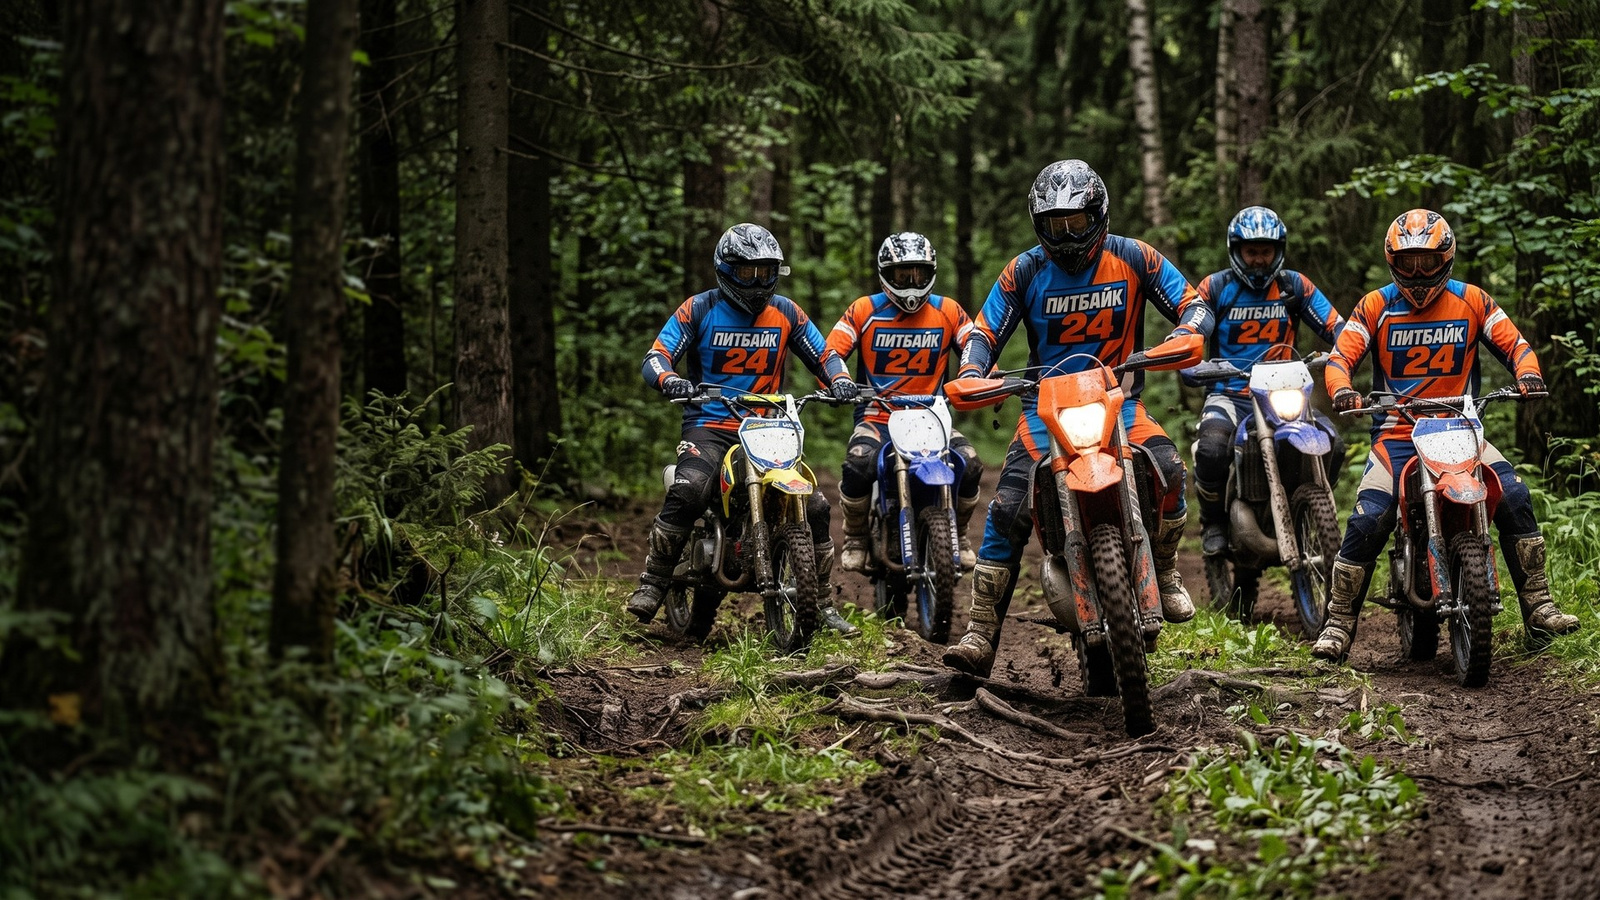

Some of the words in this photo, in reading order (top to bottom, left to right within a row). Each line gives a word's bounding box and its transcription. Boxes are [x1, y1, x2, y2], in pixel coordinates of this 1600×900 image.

[1045, 286, 1124, 314] ПИТБАЙК
[1228, 302, 1286, 320] ПИТБАЙК
[712, 330, 778, 347] ПИТБАЙК
[1059, 307, 1114, 344] 24
[1237, 318, 1280, 344] 24
[1390, 323, 1465, 346] ПИТБАЙК
[875, 331, 940, 348] ПИТБАЙК
[721, 347, 768, 374] 24
[884, 348, 931, 374] 24
[1402, 344, 1455, 375] 24
